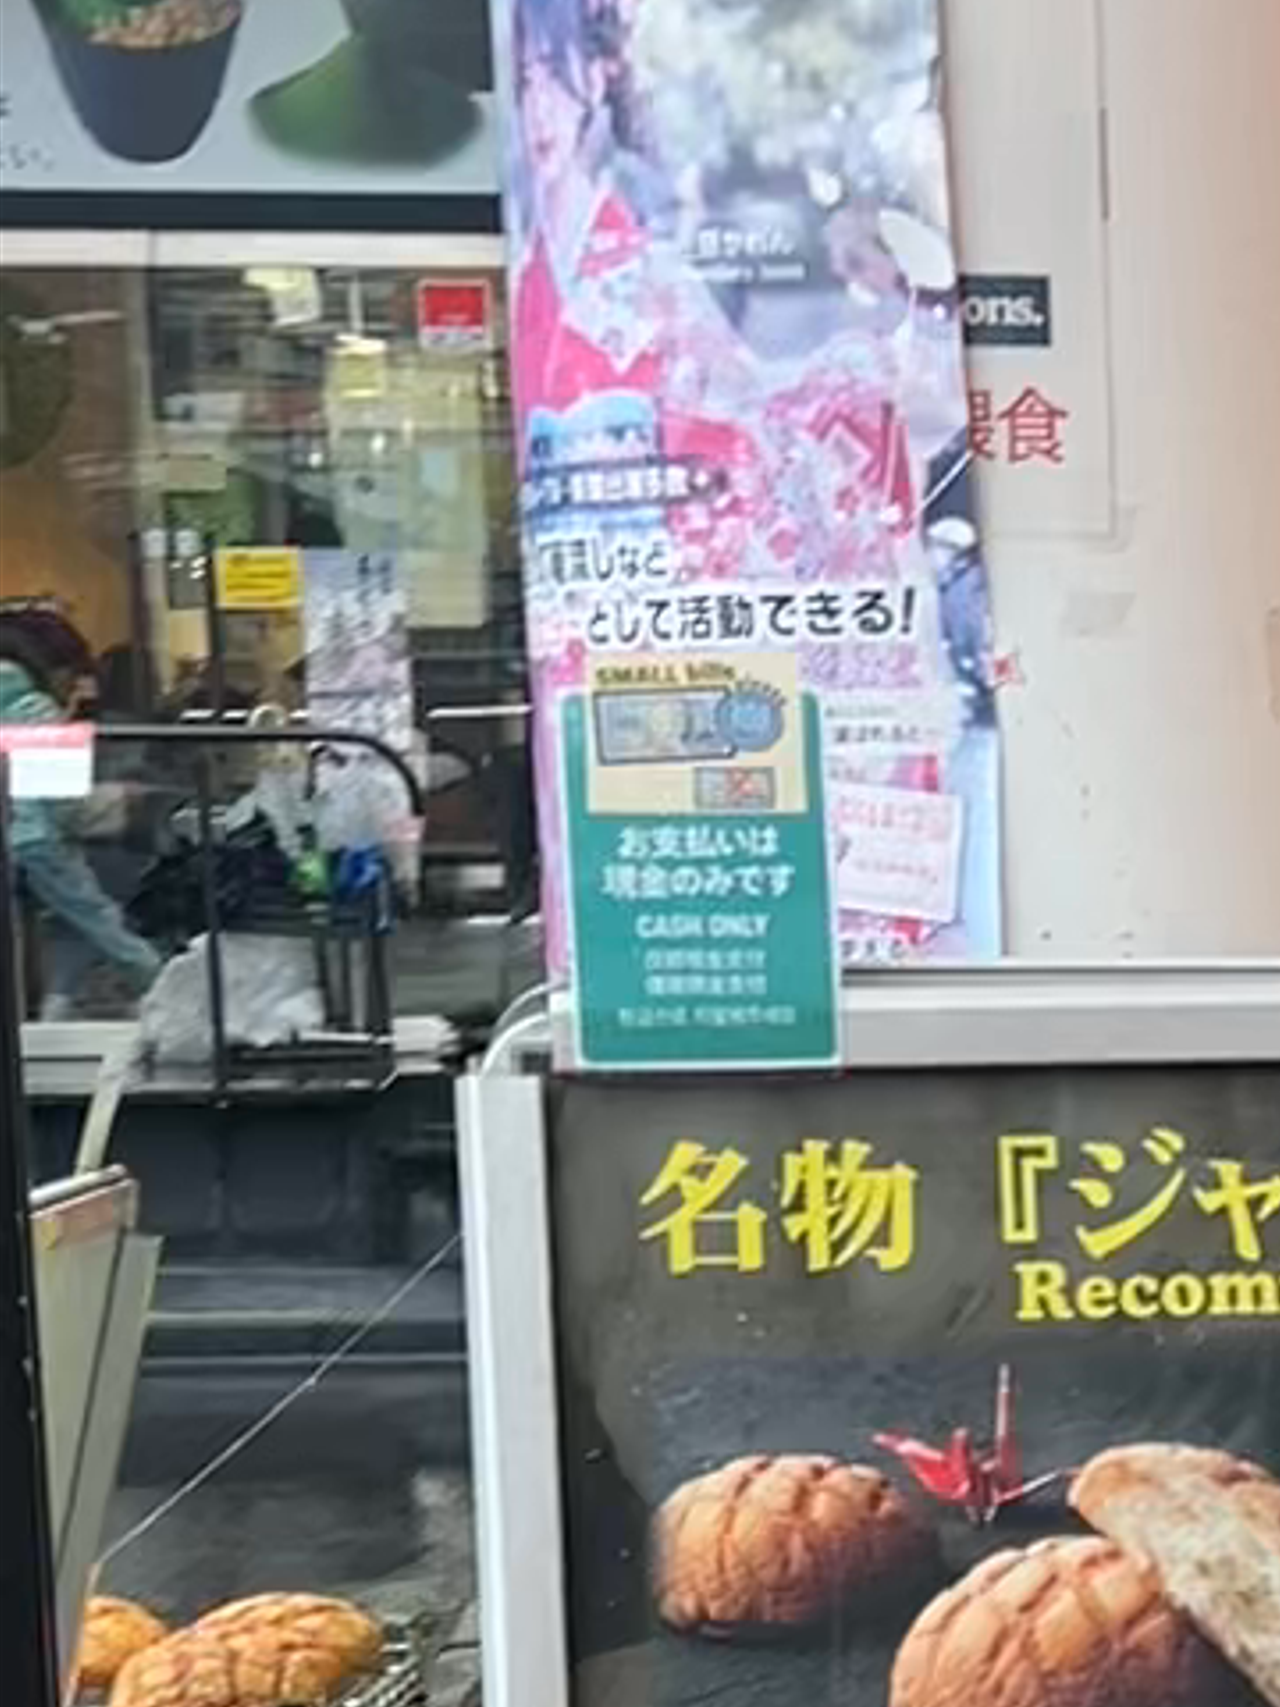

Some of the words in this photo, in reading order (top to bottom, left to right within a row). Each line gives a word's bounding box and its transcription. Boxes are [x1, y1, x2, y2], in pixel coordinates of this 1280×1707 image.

[617, 825, 779, 859] お支払いは
[639, 1138, 918, 1275] 名物
